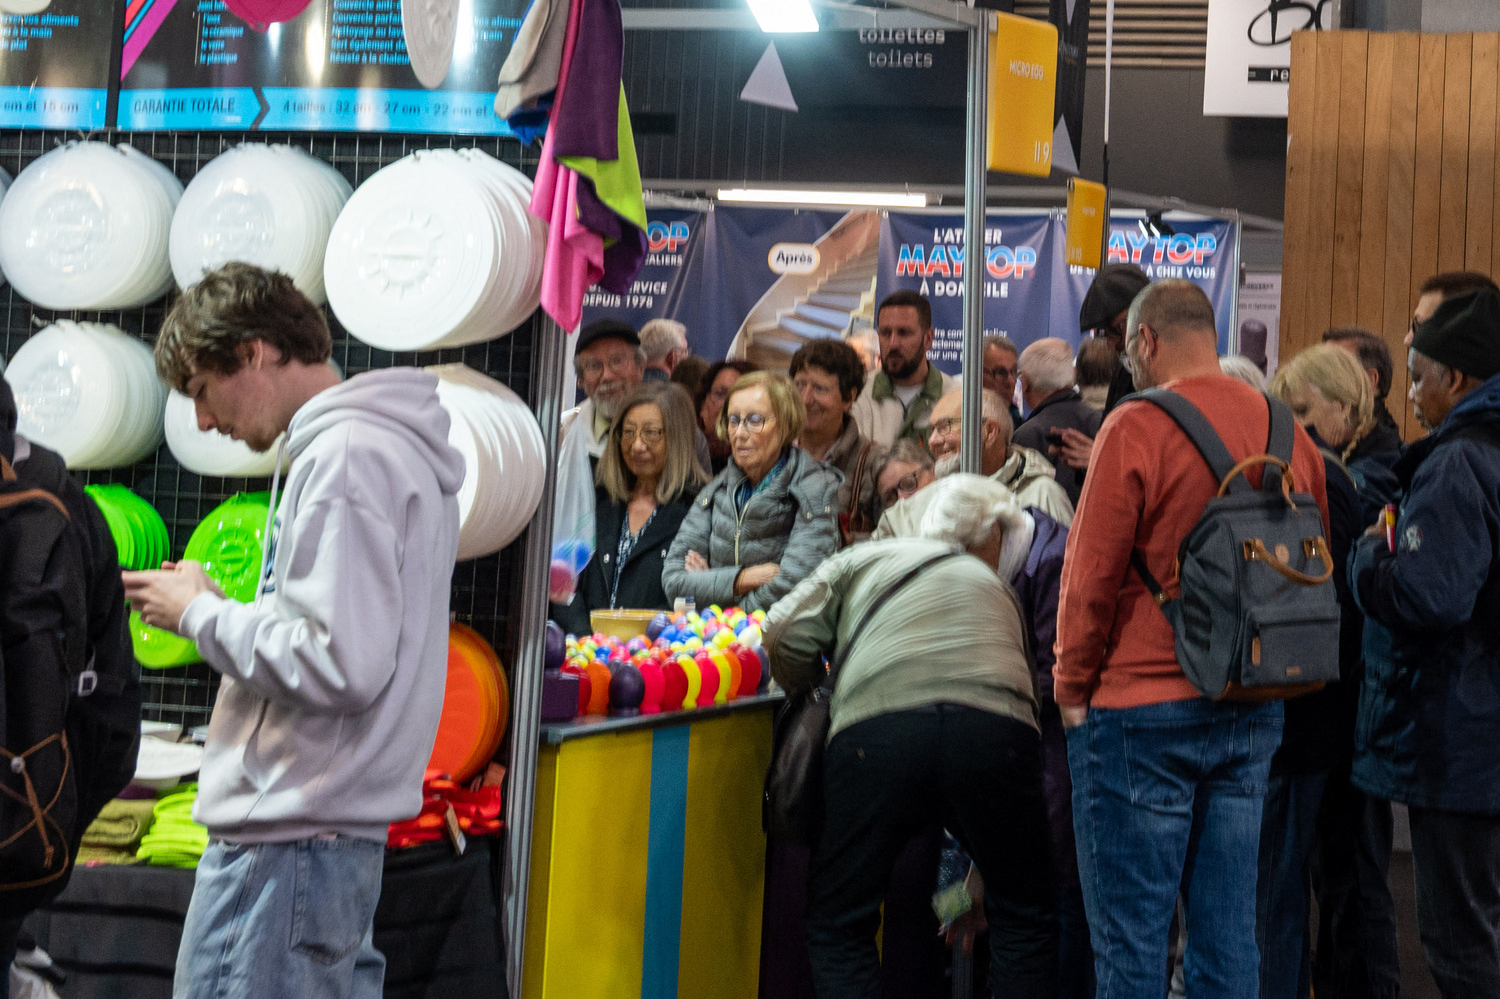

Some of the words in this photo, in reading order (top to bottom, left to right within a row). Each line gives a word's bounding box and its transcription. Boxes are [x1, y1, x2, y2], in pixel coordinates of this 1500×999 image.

[41, 12, 79, 27] aliments
[332, 12, 373, 25] Couvercle
[491, 14, 522, 30] alimen
[332, 25, 374, 41] Nettoyage
[858, 27, 946, 44] toilettes
[868, 48, 934, 69] toilets
[1009, 59, 1031, 78] MICRO
[134, 97, 186, 114] GARANTIE
[190, 96, 236, 114] TOTALE
[1042, 141, 1050, 165] 9
[933, 226, 1003, 244] L'ATER
[1108, 230, 1217, 266] AYTOP
[775, 249, 813, 268] Après
[896, 242, 1038, 280] MAYOP
[1156, 264, 1184, 279] CHEZ
[1186, 266, 1216, 280] VOUS
[631, 280, 668, 296] RVICE
[582, 293, 621, 309] DEPUIS
[625, 294, 654, 310] 1978
